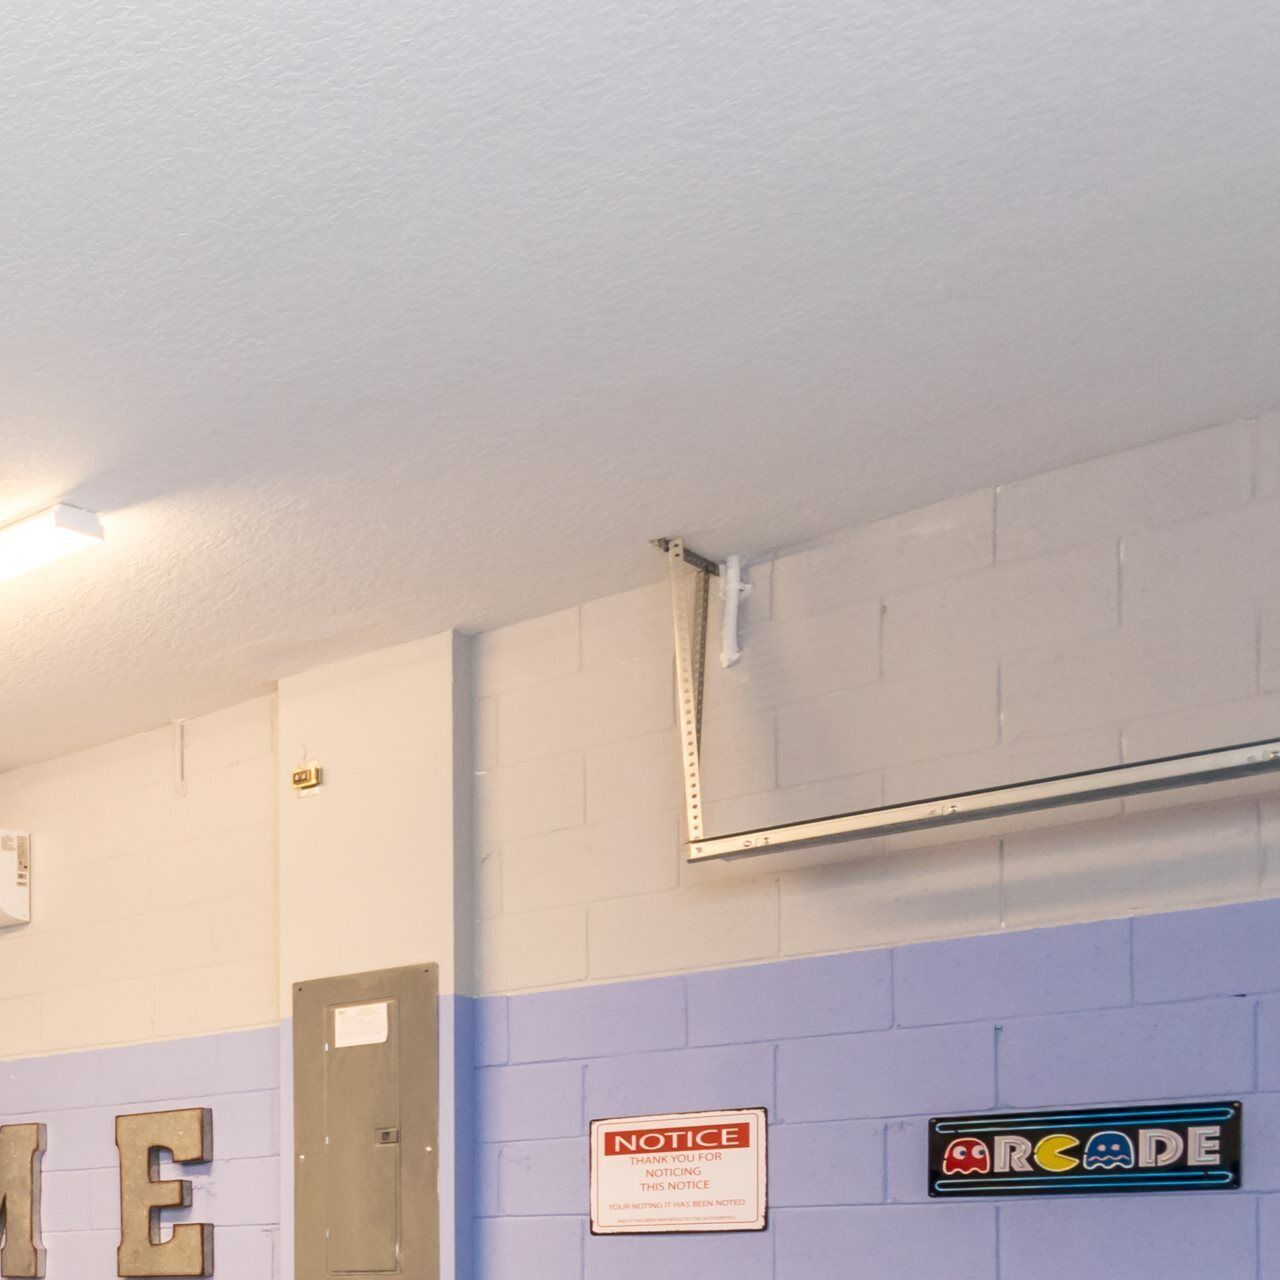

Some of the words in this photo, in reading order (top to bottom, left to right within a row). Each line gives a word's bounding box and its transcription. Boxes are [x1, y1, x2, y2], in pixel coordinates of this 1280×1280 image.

[614, 1127, 740, 1152] NOTICE
[942, 1125, 1221, 1175] ARCADE
[629, 1155, 668, 1166] THANK
[670, 1153, 695, 1164] YOU
[698, 1151, 722, 1162] FOR
[645, 1166, 702, 1178] NOTICING
[639, 1181, 665, 1192] THIS
[667, 1179, 711, 1191] NOTICE
[631, 1201, 663, 1210] NOTING
[664, 1200, 672, 1208] IT
[673, 1200, 690, 1208] HAS
[692, 1199, 713, 1208] BEEN
[715, 1198, 746, 1207] NOTED
